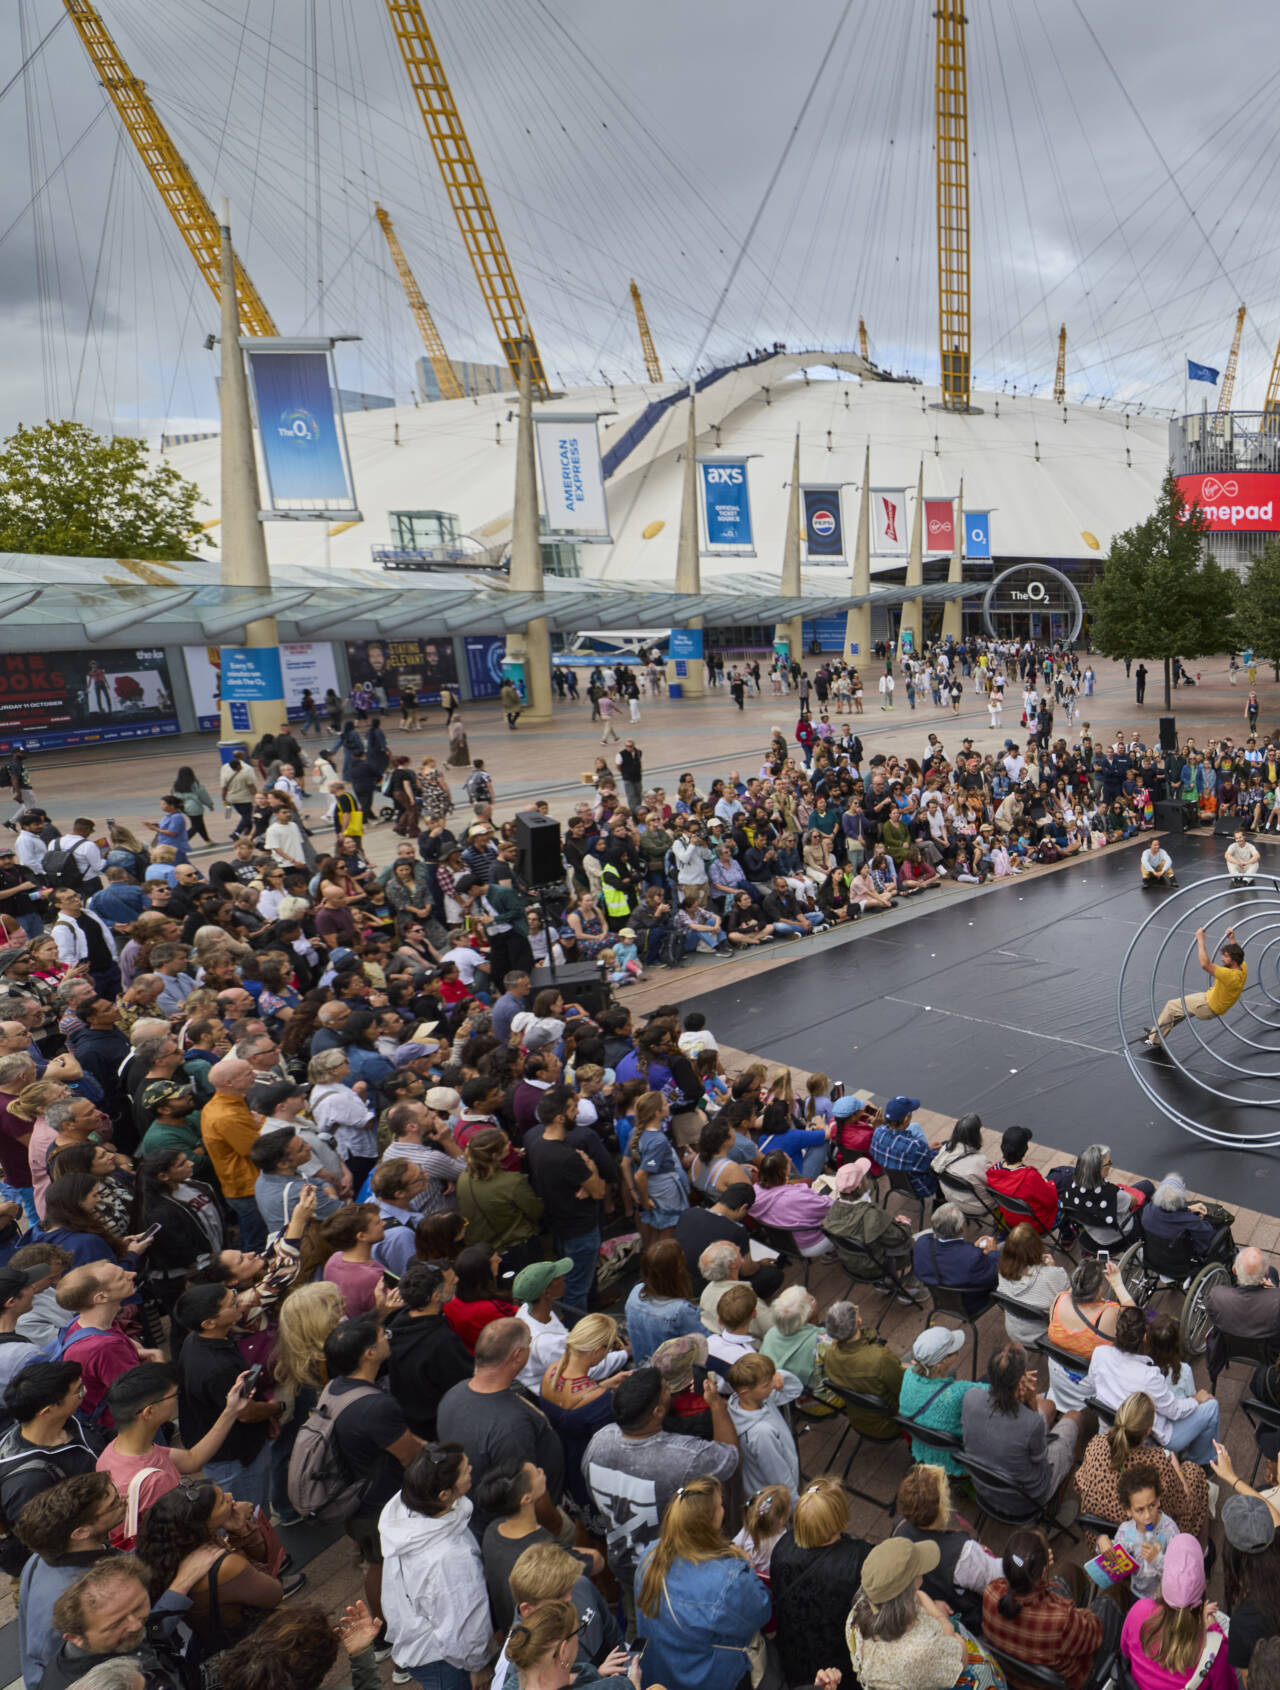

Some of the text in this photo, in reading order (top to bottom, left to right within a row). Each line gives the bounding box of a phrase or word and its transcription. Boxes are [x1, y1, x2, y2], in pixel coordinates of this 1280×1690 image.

[278, 427, 294, 436] The
[559, 439, 575, 512] AMERICAN
[569, 438, 584, 501] EXPRESS
[707, 467, 744, 486] axs
[1010, 591, 1028, 600] The
[30, 700, 63, 708] OCTOBER
